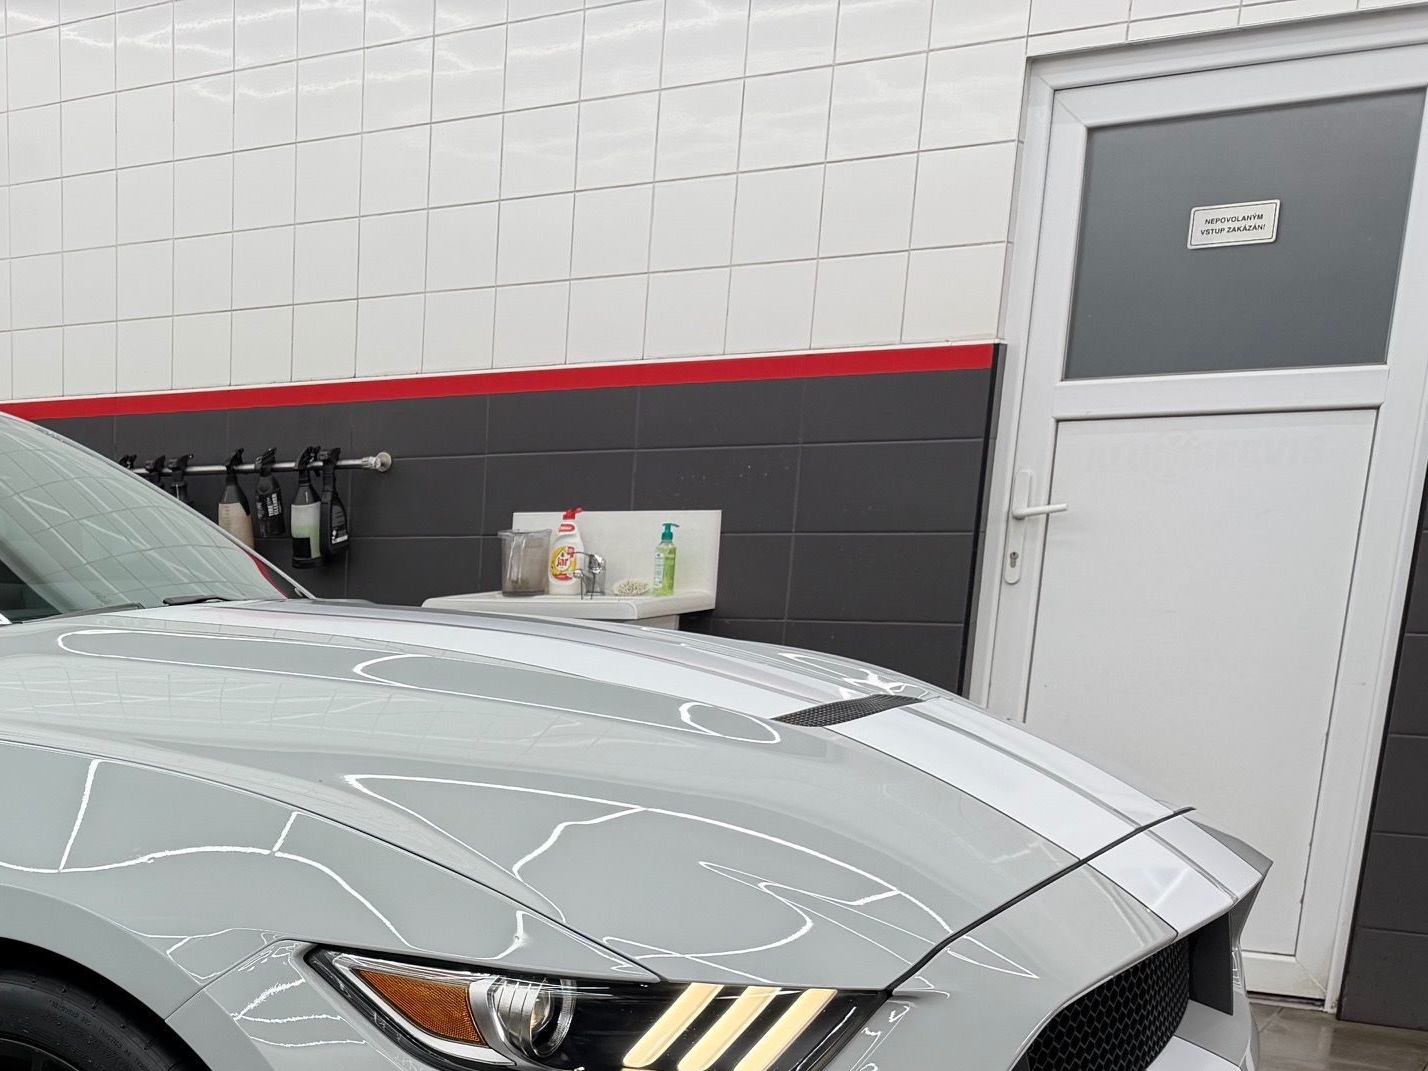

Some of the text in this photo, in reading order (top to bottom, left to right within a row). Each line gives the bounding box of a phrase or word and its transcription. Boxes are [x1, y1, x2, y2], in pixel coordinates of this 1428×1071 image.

[1204, 213, 1263, 224] NEPOVOLANÝM
[1200, 223, 1266, 236] VSTUP ZAKÁZÁN!
